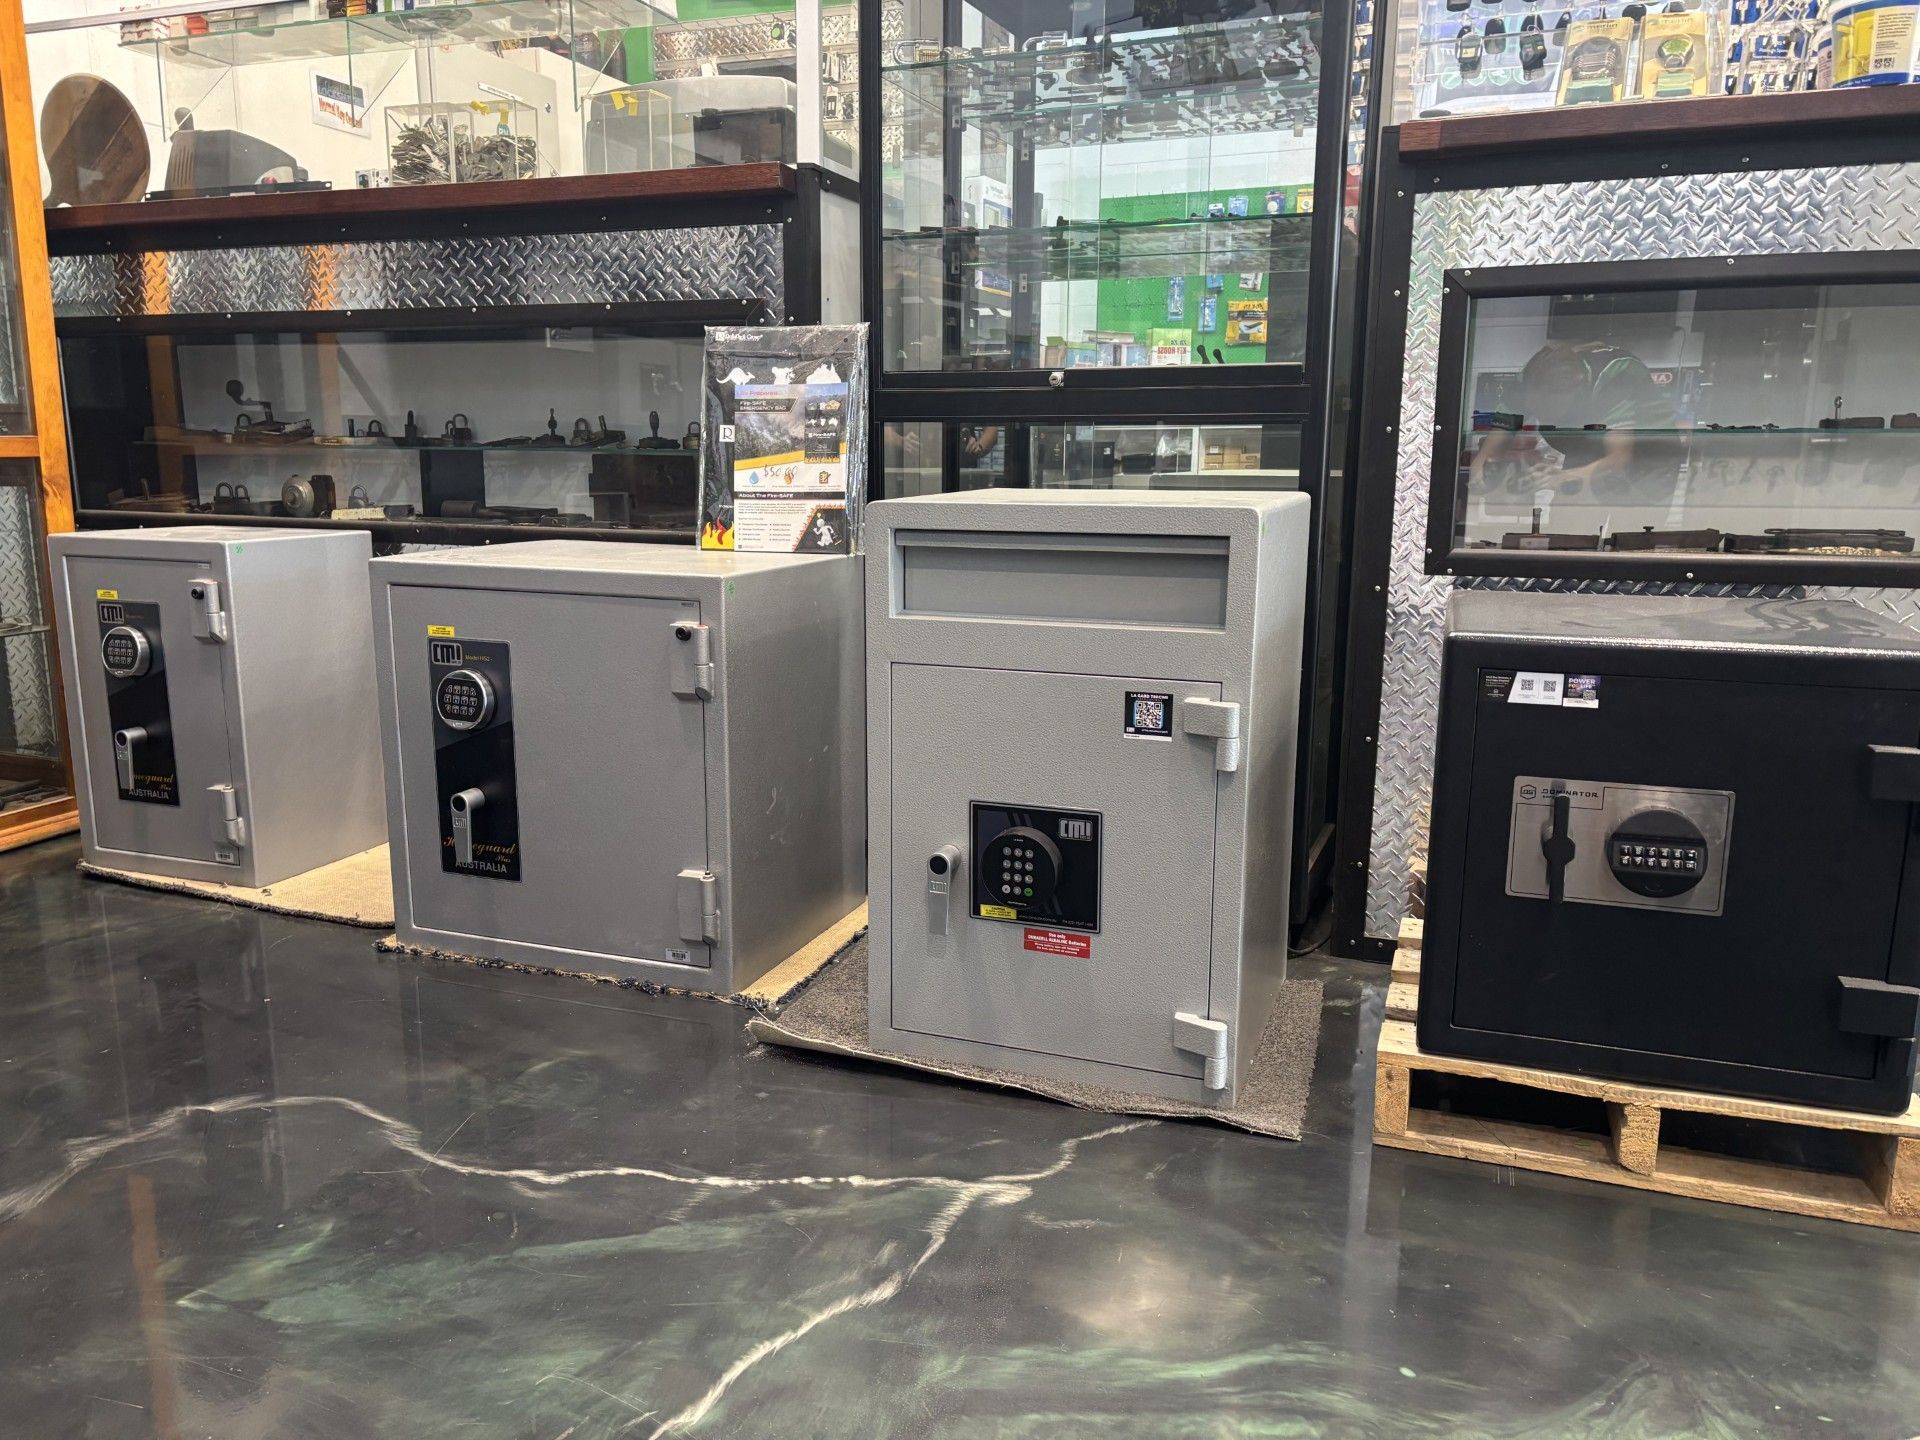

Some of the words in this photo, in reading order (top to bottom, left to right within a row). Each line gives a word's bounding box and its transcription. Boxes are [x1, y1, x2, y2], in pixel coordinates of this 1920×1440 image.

[722, 426, 733, 440] R
[128, 789, 169, 800] AUSTRALIA
[1541, 788, 1599, 798] DOMINATOR
[455, 860, 508, 873] AUSTRALIA
